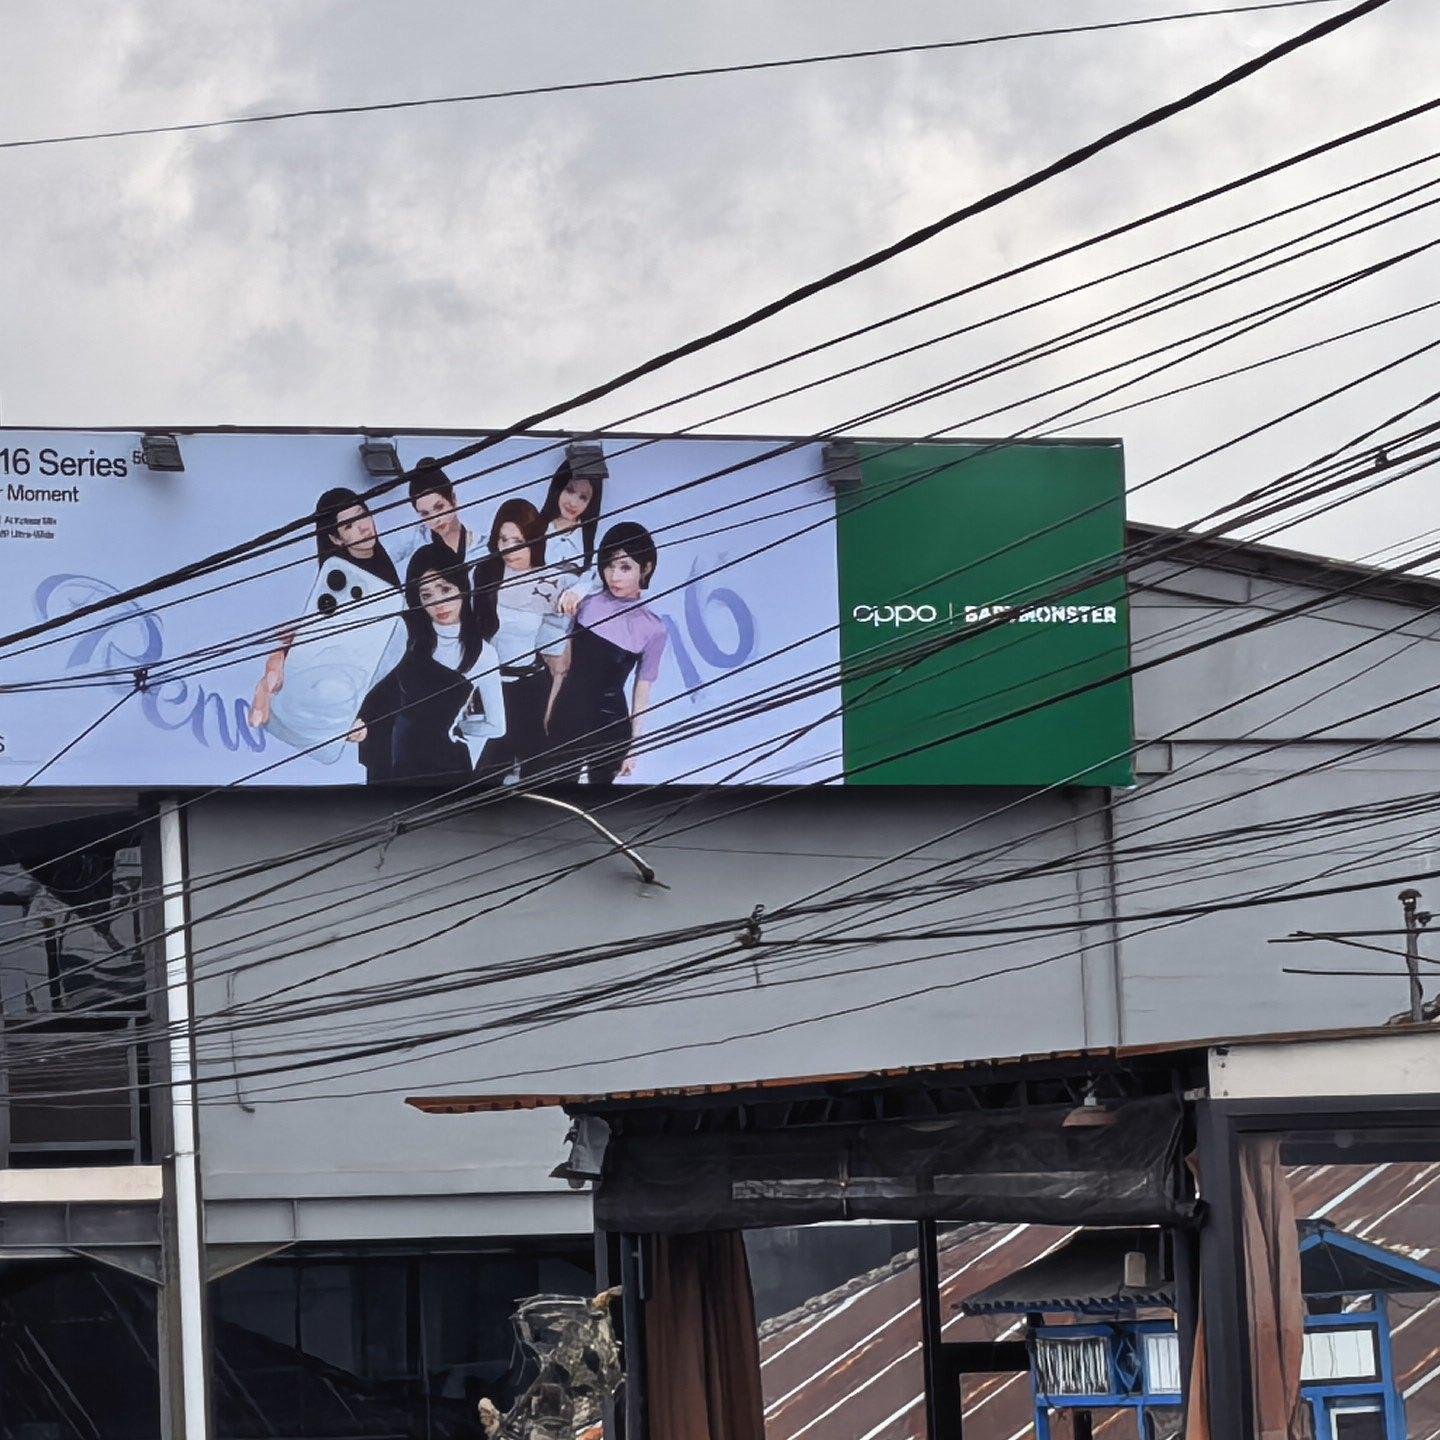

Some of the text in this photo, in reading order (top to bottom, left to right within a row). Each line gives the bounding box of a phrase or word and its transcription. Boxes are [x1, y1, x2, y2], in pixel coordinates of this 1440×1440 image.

[39, 448, 128, 478] Series
[7, 484, 80, 502] Moment
[853, 605, 937, 627] oppo
